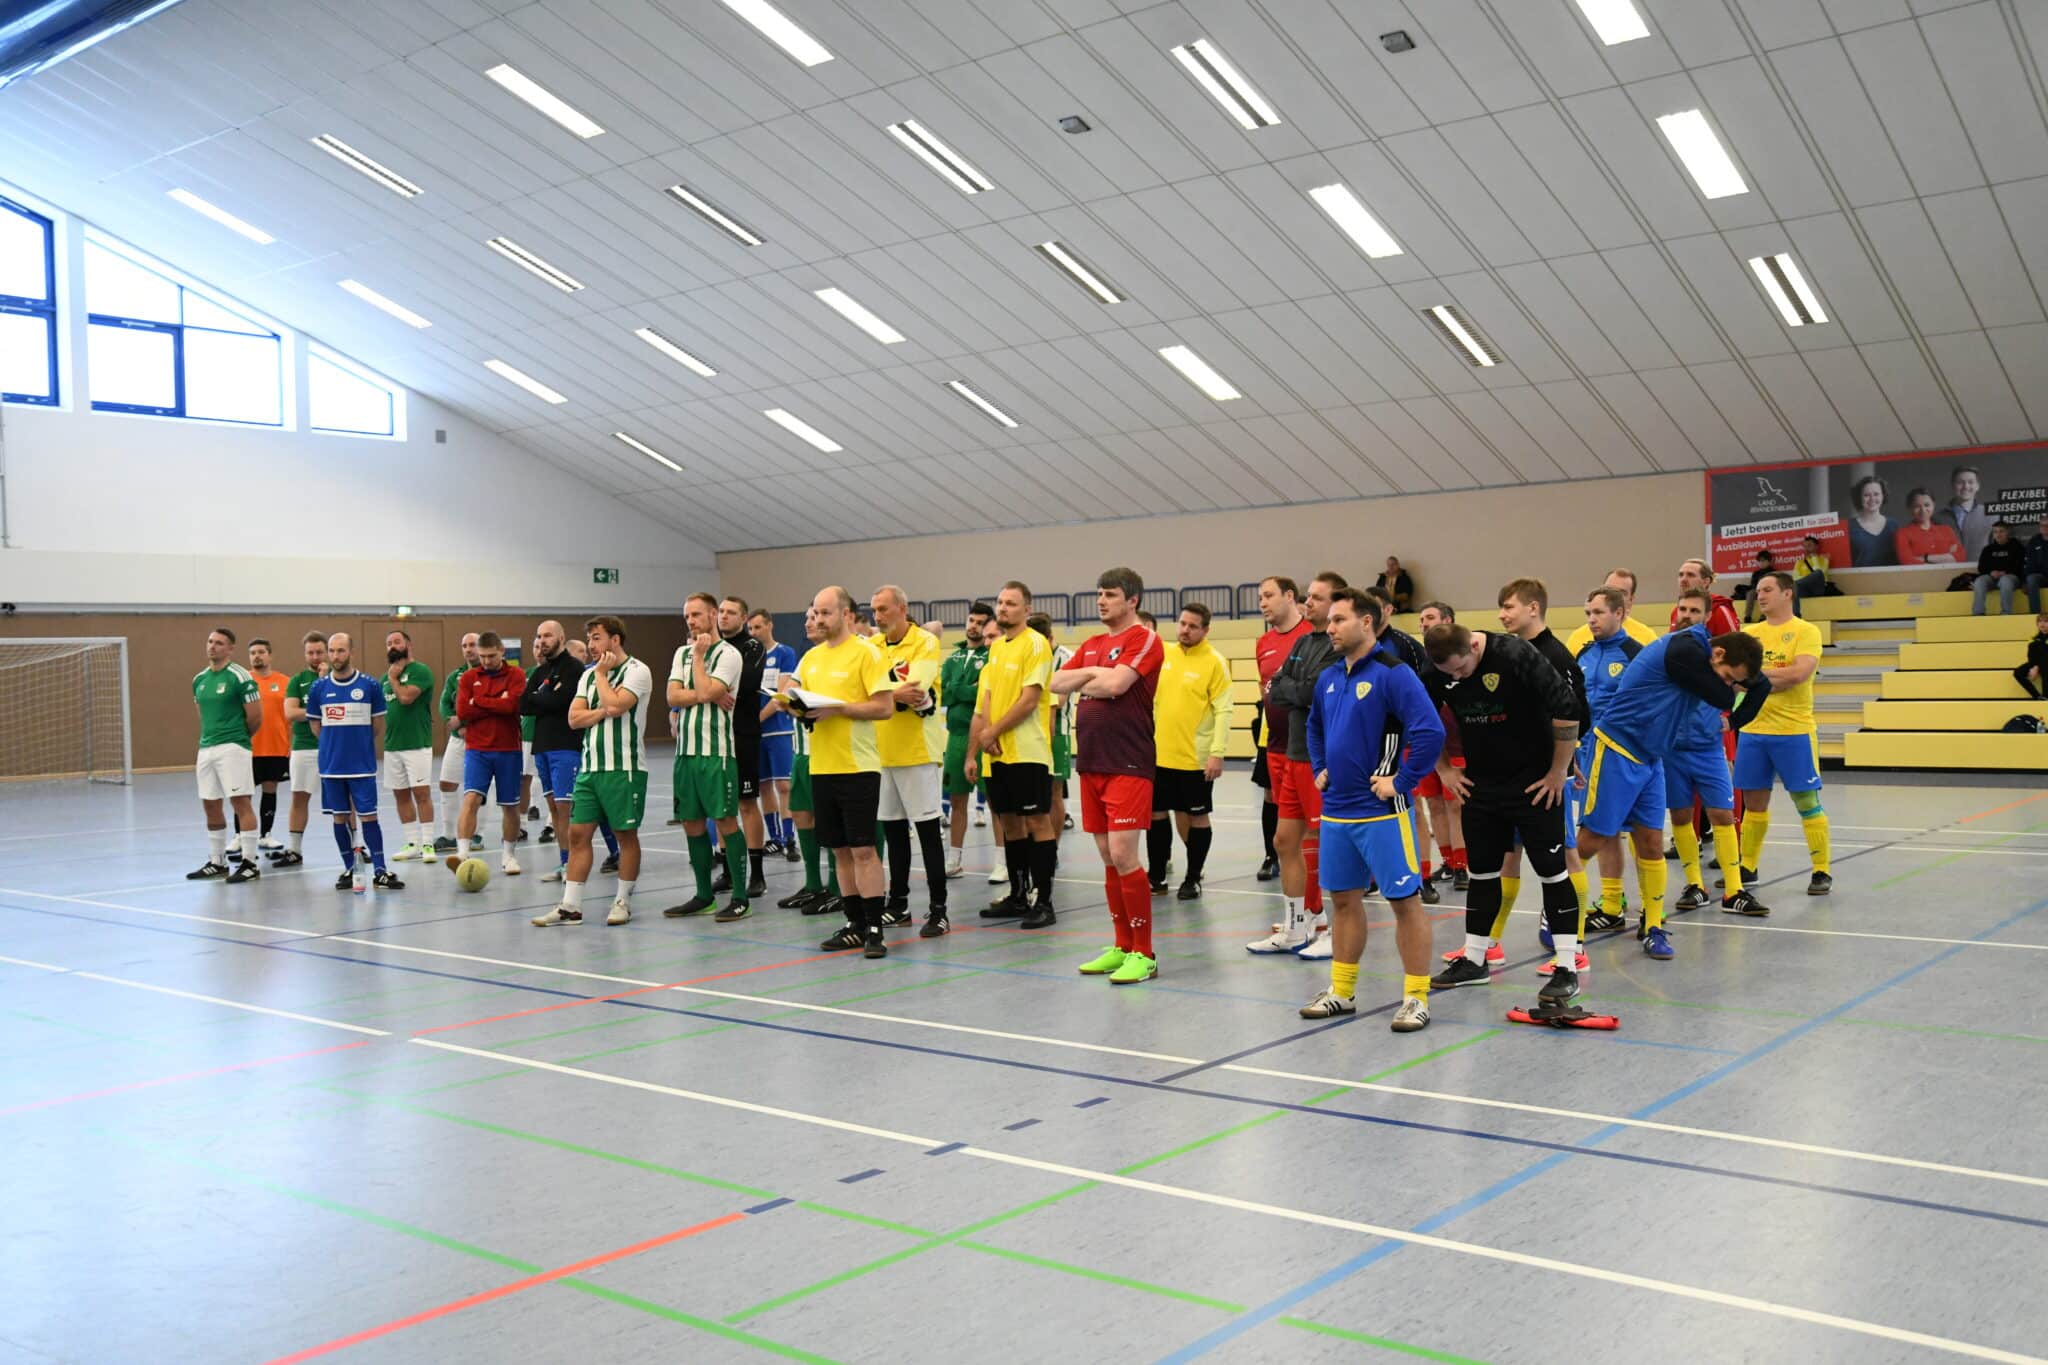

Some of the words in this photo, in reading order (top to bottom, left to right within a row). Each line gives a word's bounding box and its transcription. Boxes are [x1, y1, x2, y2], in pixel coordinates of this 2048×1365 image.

[2001, 488, 2047, 500] FLEXIBEL
[1987, 501, 2048, 513] KRISENFEST
[1724, 526, 1747, 537] Jetzt
[1749, 519, 1804, 533] bewerben!
[1716, 538, 1767, 553] Ausbildung
